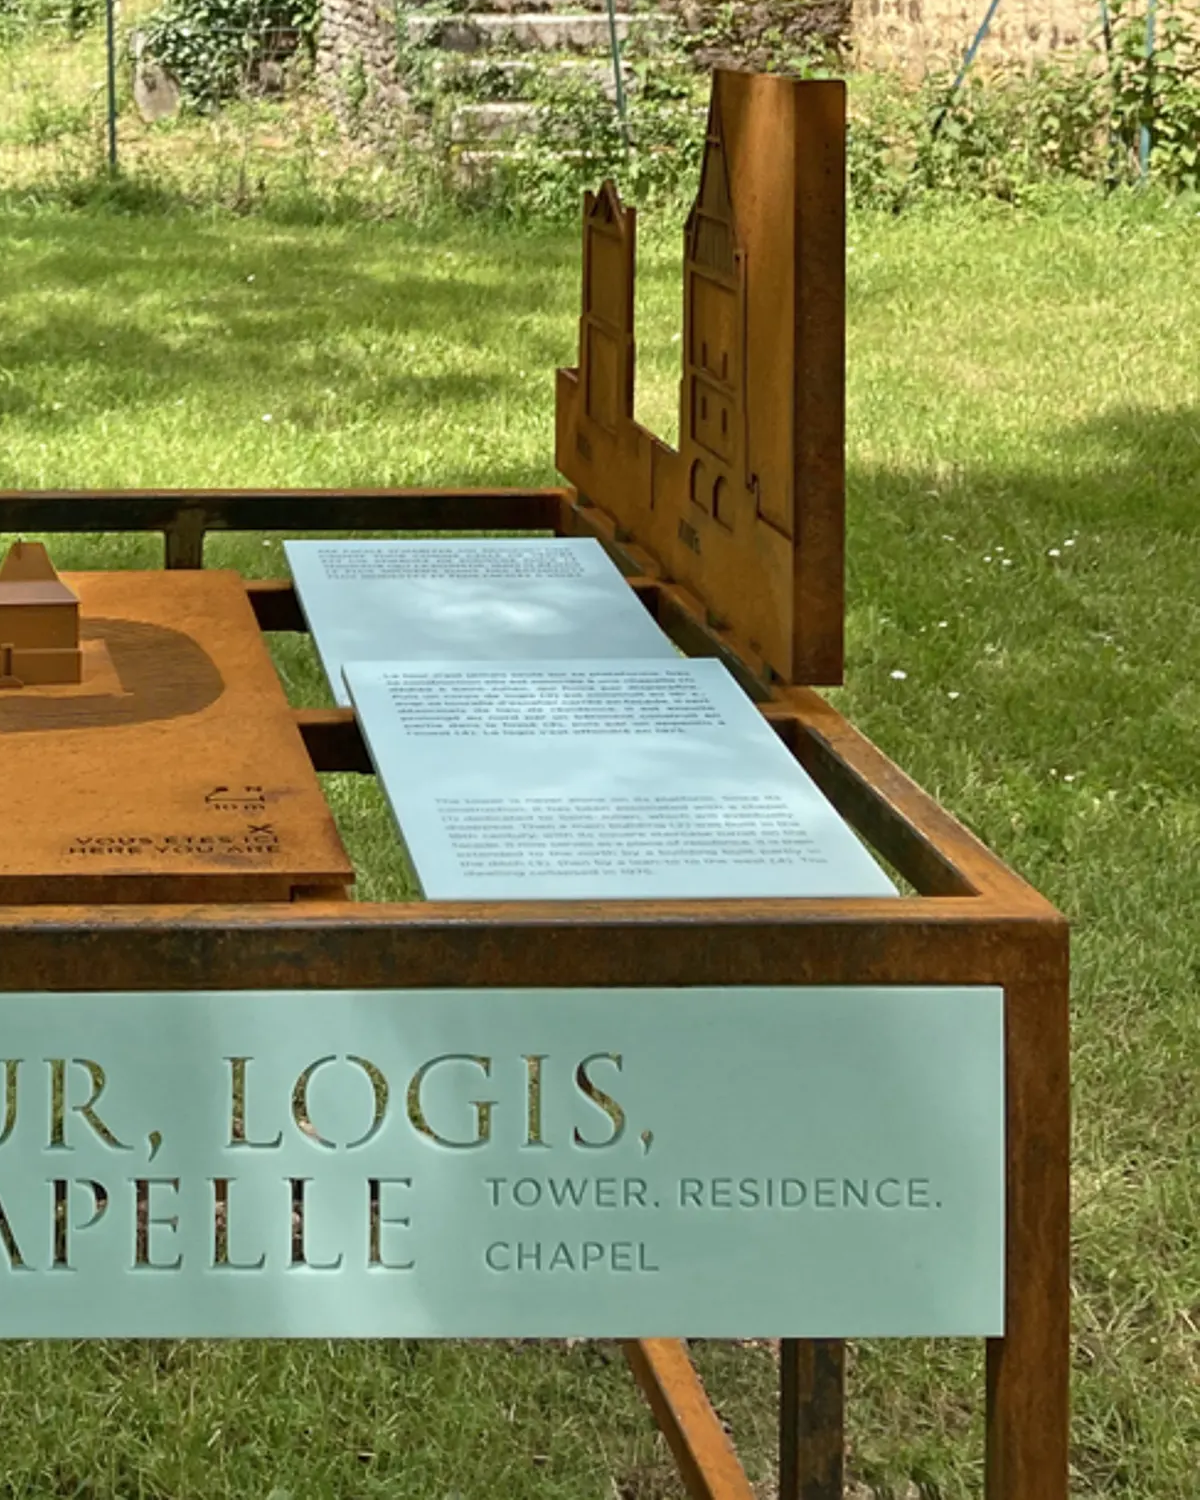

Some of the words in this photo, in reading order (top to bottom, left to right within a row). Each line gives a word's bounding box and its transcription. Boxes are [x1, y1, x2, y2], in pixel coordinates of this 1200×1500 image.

[222, 1052, 654, 1154] LOGIS,
[484, 1177, 661, 1208] TOWER.
[678, 1177, 944, 1208] RESIDENCE.
[485, 1240, 660, 1272] CHAPEL
